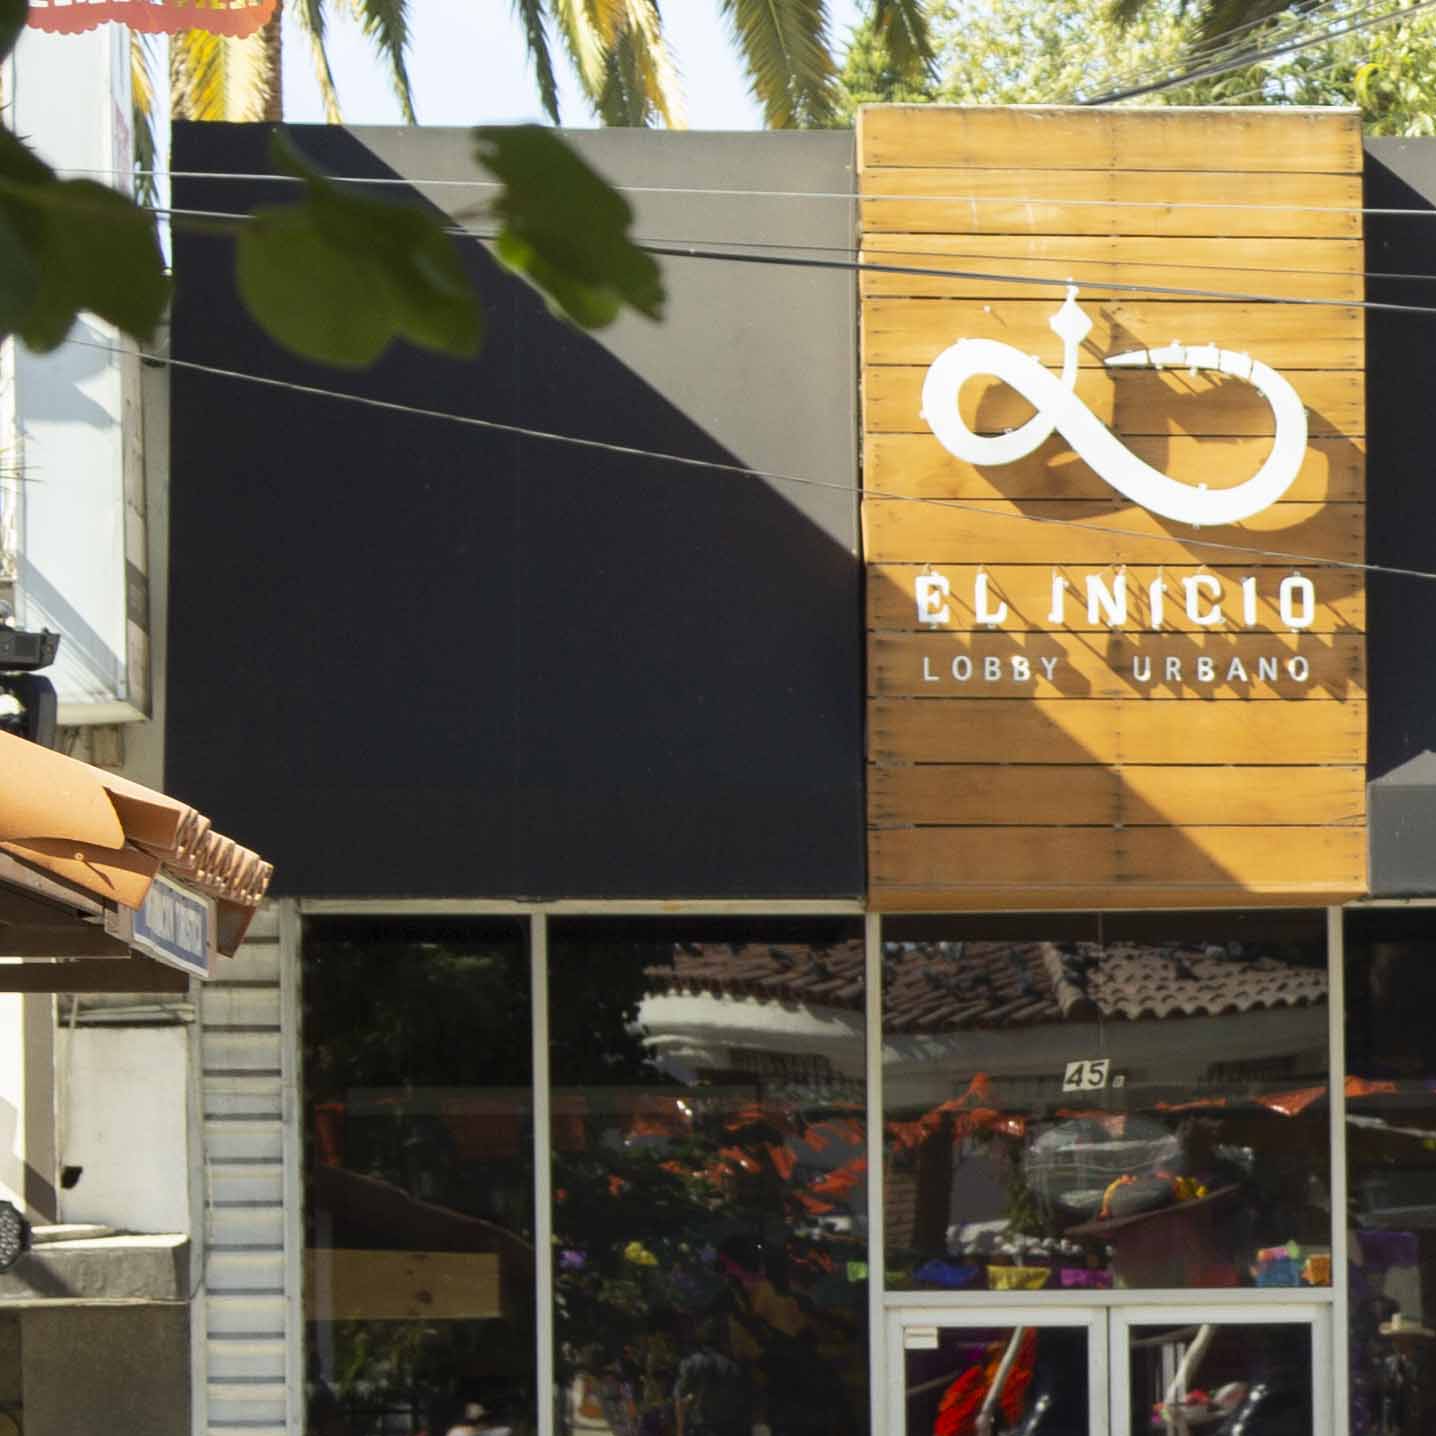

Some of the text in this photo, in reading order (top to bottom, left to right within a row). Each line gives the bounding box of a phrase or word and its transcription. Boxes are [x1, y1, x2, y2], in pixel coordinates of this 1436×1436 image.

[914, 573, 1316, 628] EL INICIO
[922, 655, 1310, 682] LOBBY URBANO
[1064, 1062, 1105, 1087] 45
